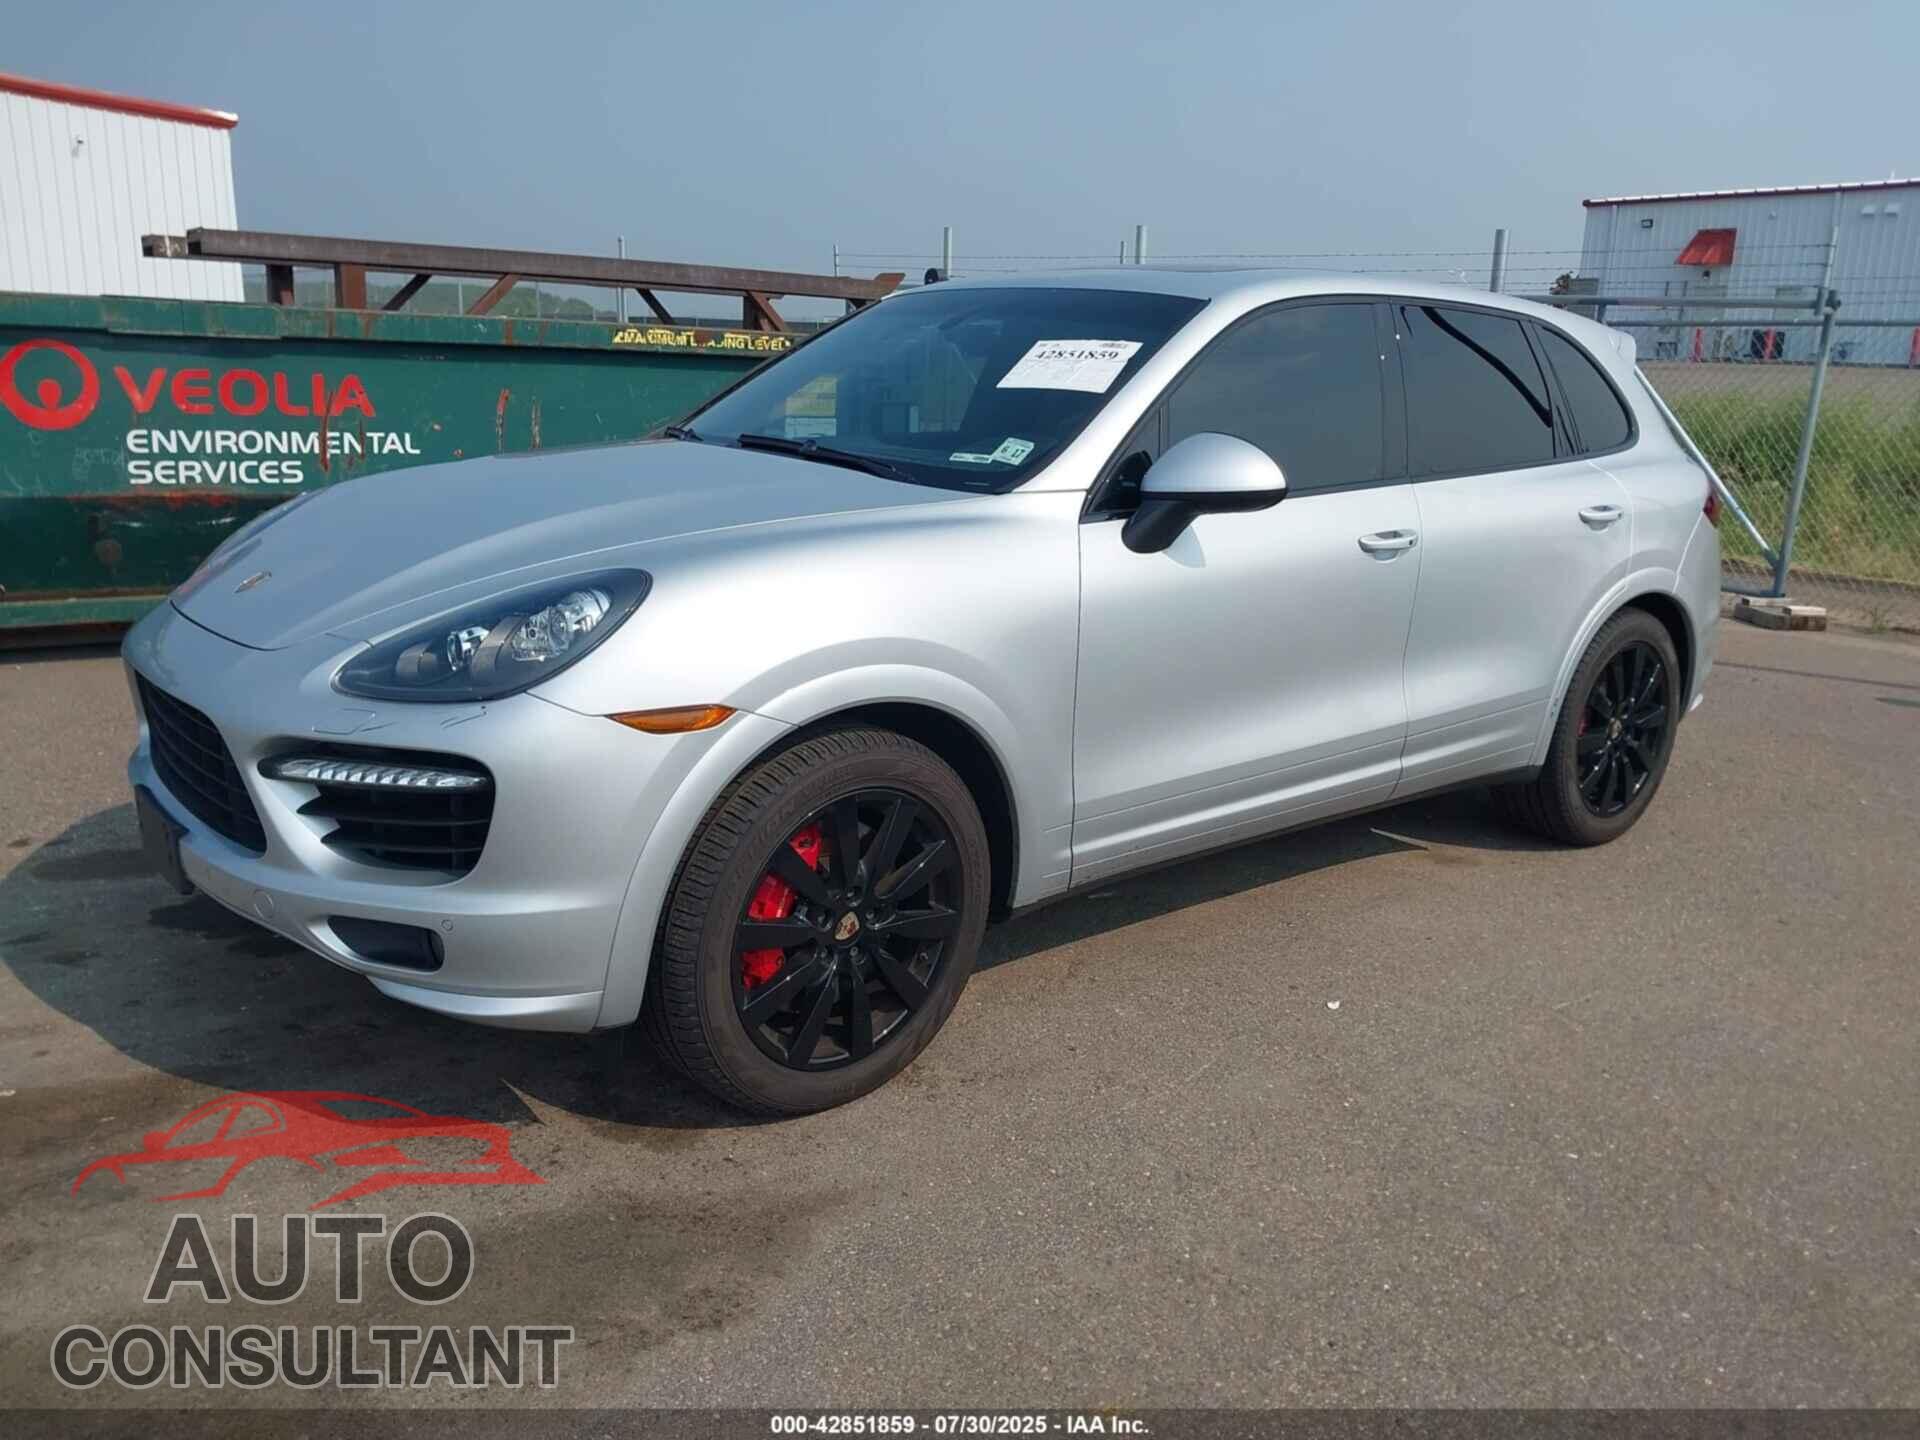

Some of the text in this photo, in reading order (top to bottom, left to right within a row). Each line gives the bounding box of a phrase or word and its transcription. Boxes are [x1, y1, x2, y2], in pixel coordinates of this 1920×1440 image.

[690, 332, 745, 349] LAING
[747, 335, 784, 351] LEVEL
[113, 366, 376, 417] VEOLIA
[126, 429, 421, 455] ENVIRONMENTAL
[129, 459, 304, 485] SERVICES
